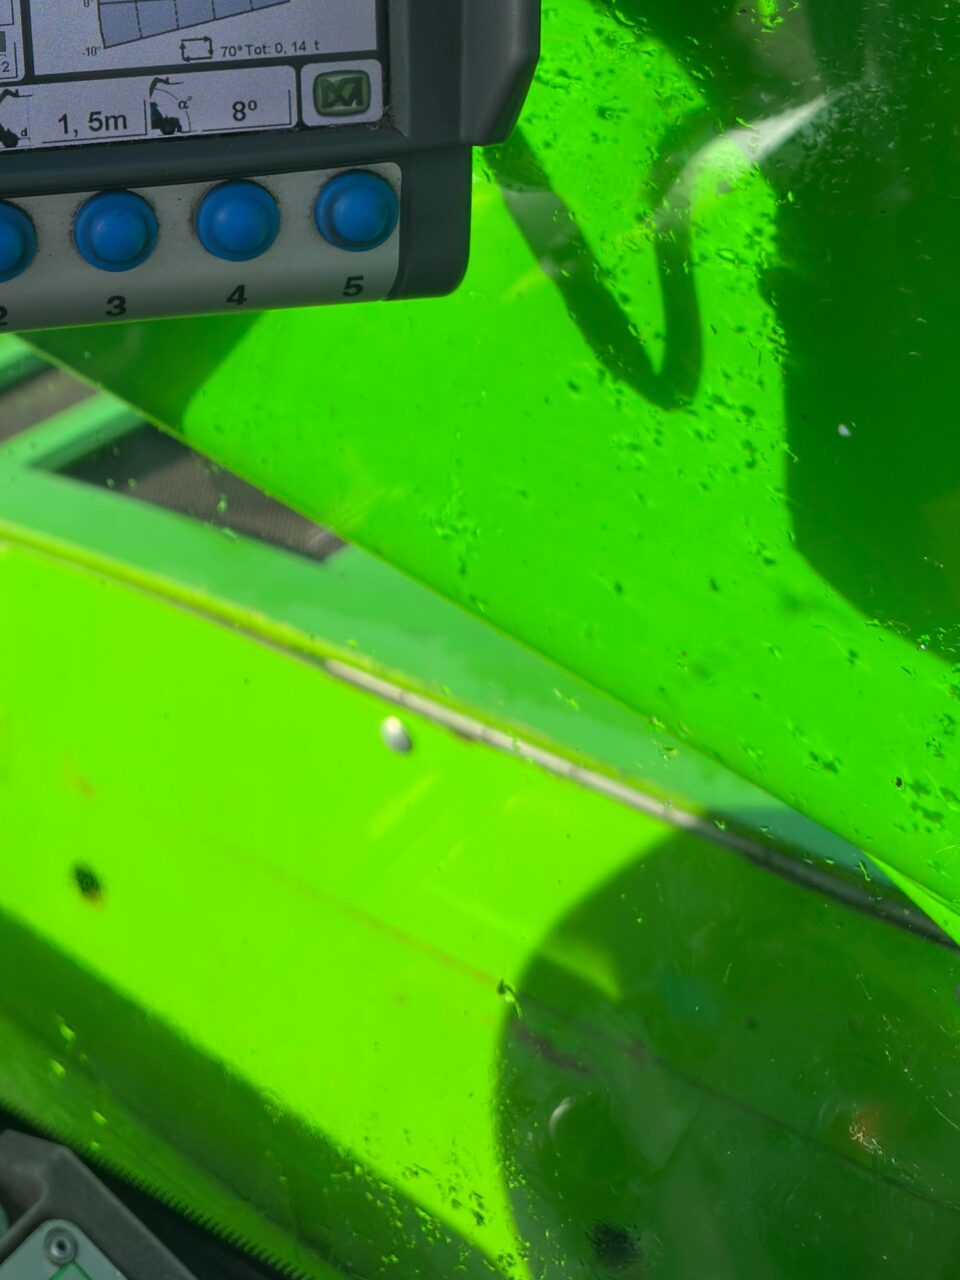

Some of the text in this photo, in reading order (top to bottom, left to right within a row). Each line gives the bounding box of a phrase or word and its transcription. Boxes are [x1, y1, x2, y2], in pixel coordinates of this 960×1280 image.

[232, 99, 258, 121] 8°
[105, 295, 126, 317] 3
[226, 284, 246, 306] 4
[343, 276, 362, 297] 5
